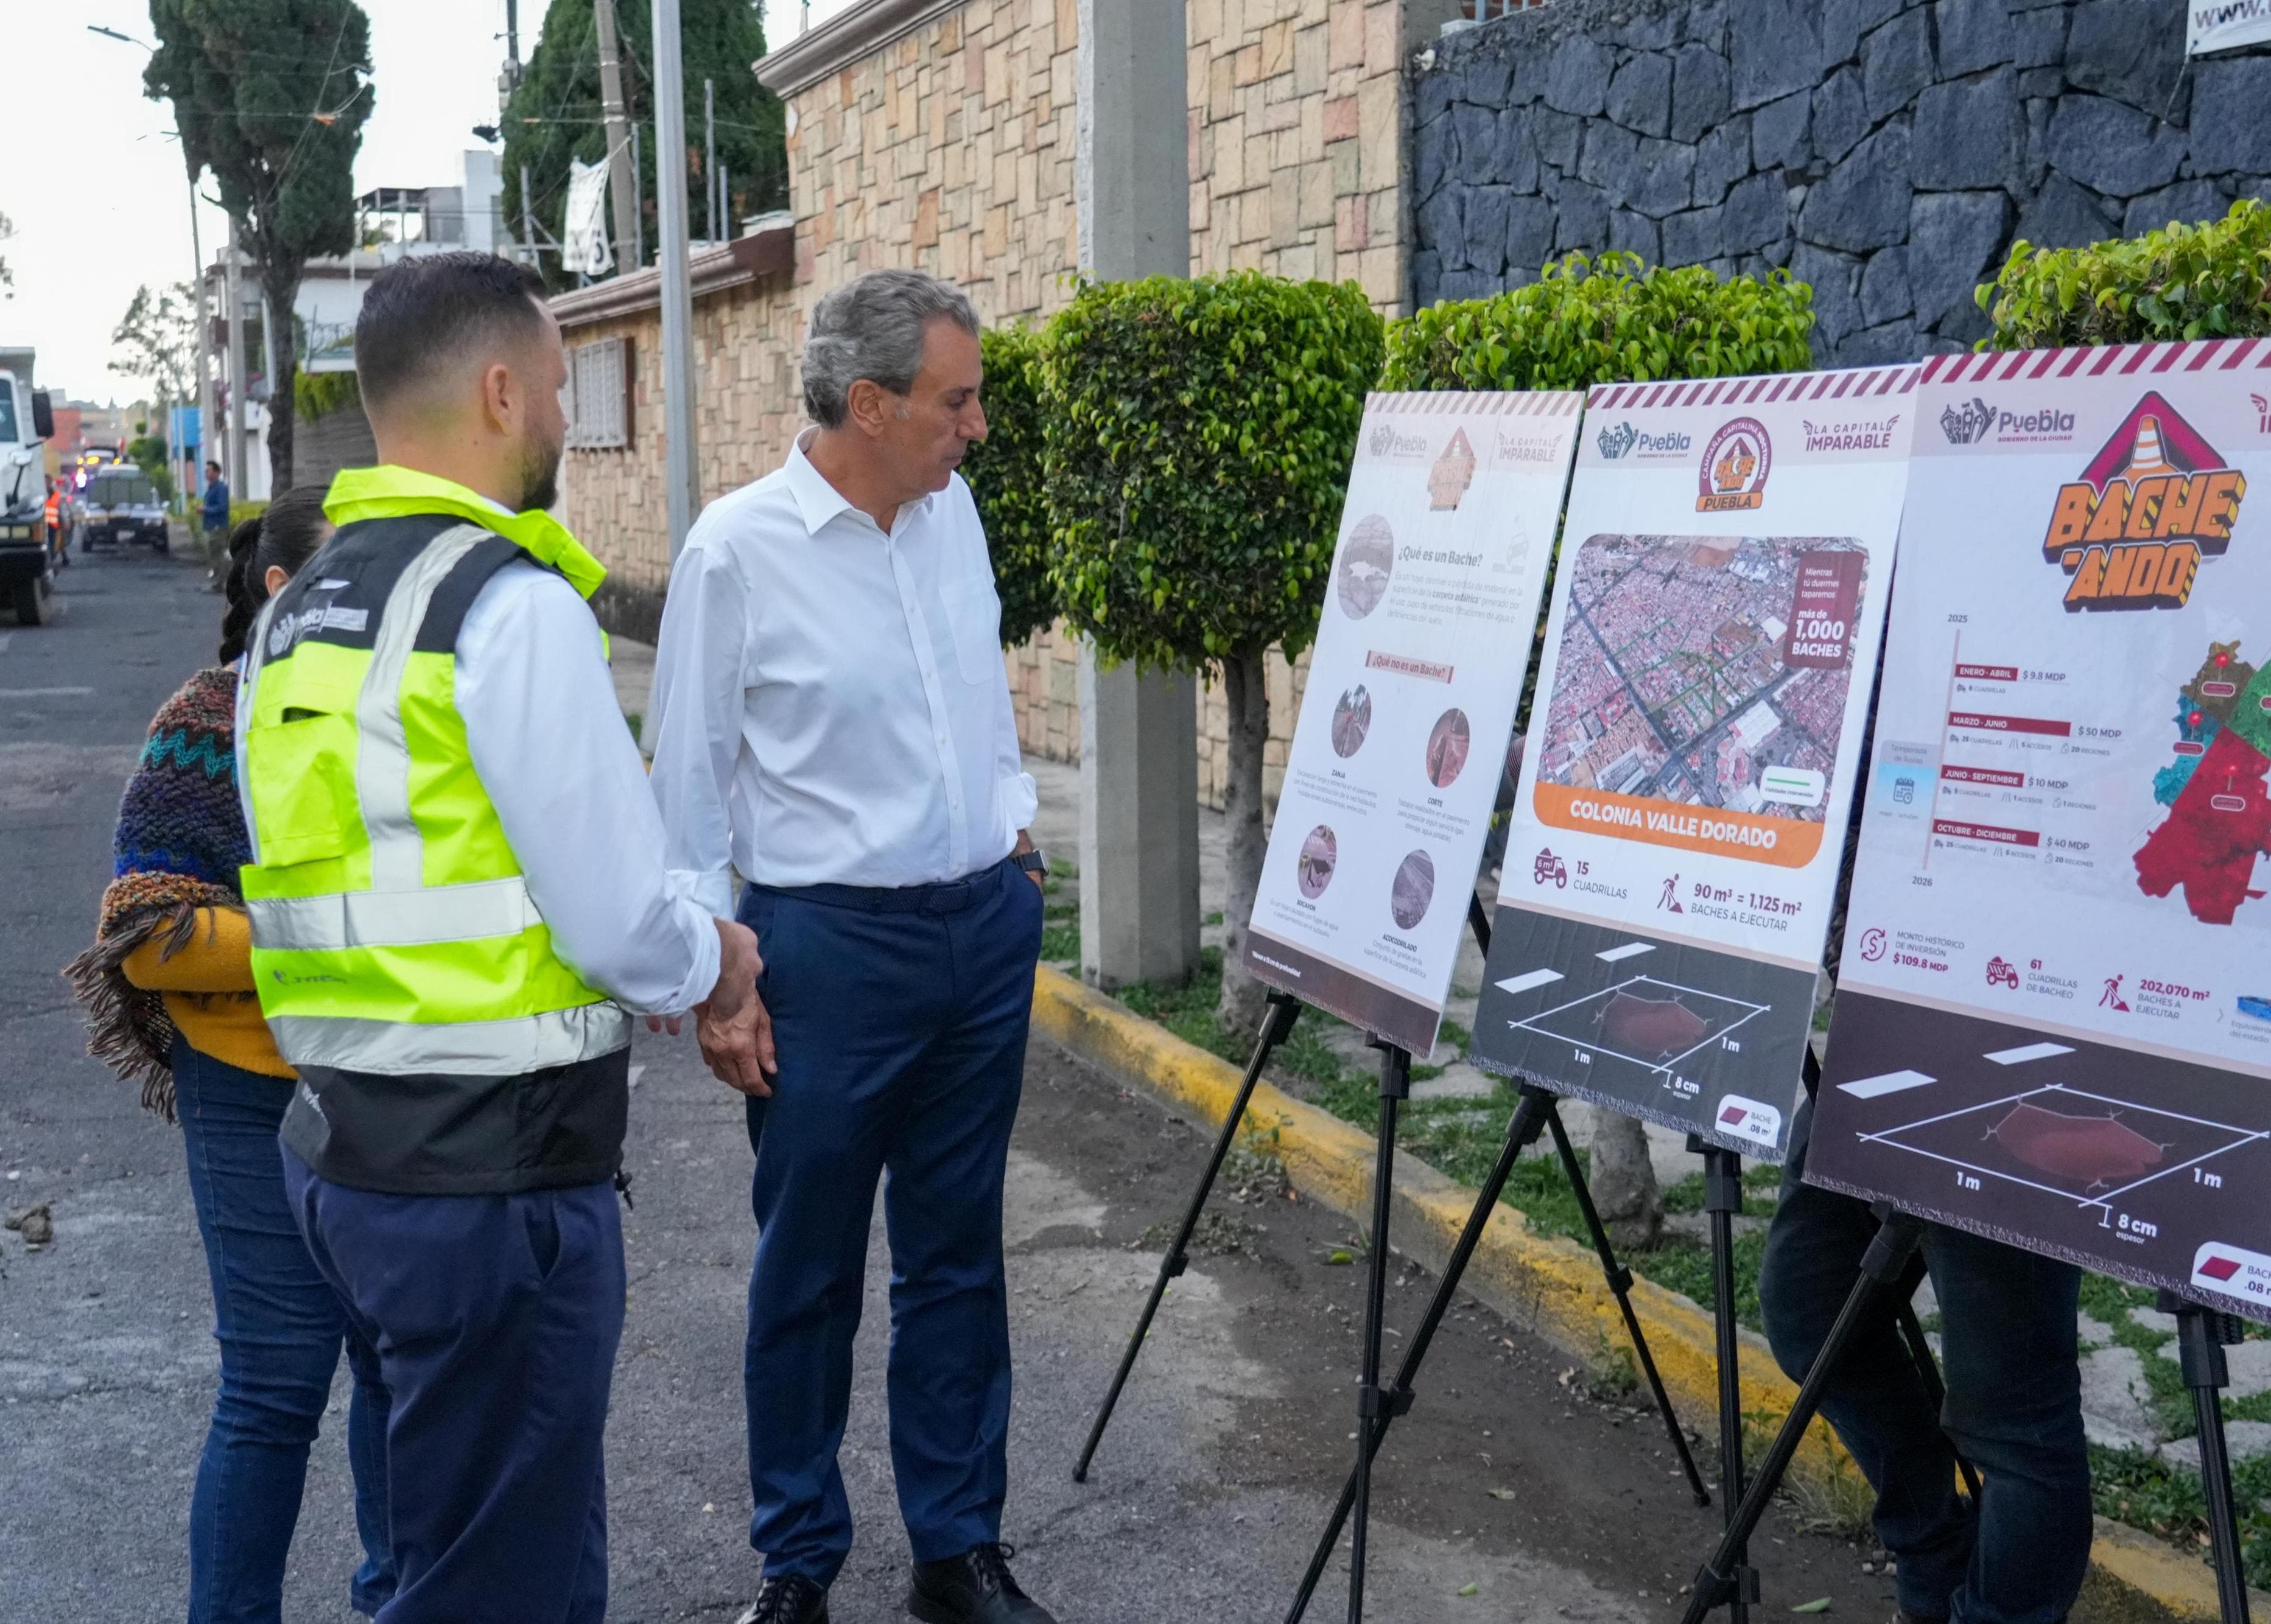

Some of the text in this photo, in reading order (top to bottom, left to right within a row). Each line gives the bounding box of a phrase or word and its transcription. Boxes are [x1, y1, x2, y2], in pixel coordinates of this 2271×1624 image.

[1814, 420, 1888, 433] LA CAPITAL
[1998, 408, 2075, 434] Puebla
[1638, 432, 1691, 452] Puebla
[1805, 433, 1891, 452] IMPARABLE
[1498, 447, 1556, 463] IMPARABLE
[1702, 422, 1768, 480] CAMPAÑA CAPITALINA NOCTURNA
[1704, 495, 1752, 510] PUEBLA
[2043, 470, 2246, 563] BACHE
[1398, 545, 1483, 567] ¿Qué es un Bache?
[1805, 567, 1833, 576] Mientras
[2062, 541, 2202, 612] ANDO
[1803, 579, 1839, 588] tú duermes
[1801, 590, 1836, 599] taparemos
[1798, 608, 1828, 619] más de
[1948, 614, 1968, 623] 2025
[1795, 618, 1845, 641] 1,000
[1792, 641, 1842, 658] BACHES
[1372, 655, 1445, 678] ¿Qué no es un Bache?
[1959, 667, 1985, 676] ENERO
[1990, 668, 2012, 678] ABRIL
[2023, 670, 2029, 681] $
[2030, 670, 2043, 681] 9.8
[2045, 672, 2066, 681] MDP
[1973, 685, 2006, 694] CUADRILLAS
[1953, 716, 1979, 726] MARZO
[1984, 719, 2008, 729] JUNIO
[2078, 726, 2085, 737] $
[2086, 727, 2098, 737] 50
[2100, 729, 2122, 738] MDP
[1970, 737, 2002, 746] CUADRILLAS
[1945, 769, 1967, 779] JUNIO
[1972, 772, 2019, 785] SEPTIEMBRE
[2028, 776, 2034, 787] $
[2035, 778, 2046, 787] 10
[2047, 780, 2069, 789] MDP
[1959, 788, 1992, 798] CUADRILLAS
[1427, 797, 1444, 808] CORTE
[1570, 799, 1778, 850] COLONIA VALLE DORADO
[1937, 824, 1972, 836] OCTUBRE
[1976, 828, 2018, 842] DICIEMBRE
[2046, 836, 2052, 847] $
[2054, 838, 2066, 848] 40
[2068, 840, 2090, 850] MDP
[1954, 842, 1987, 853] CUADRILLAS
[1537, 859, 1543, 867] 6
[1577, 860, 1590, 875] 15
[1912, 875, 1932, 887] 2026
[1573, 879, 1628, 900] CUADRILLAS
[1694, 883, 1712, 900] 90
[1713, 888, 1733, 903] m³
[1749, 892, 1781, 912] 1,125
[1781, 901, 1803, 916] m²
[1690, 902, 1789, 932] BACHES A EJECUTAR
[1897, 931, 1924, 942] MONTO
[1895, 941, 1947, 957] DE INVERSIÓN
[1893, 951, 1949, 973] $ 109.8 MDP
[2031, 959, 2042, 971] 61
[2027, 972, 2078, 989] CUADRILLAS
[2026, 984, 2074, 1000] DE BACHEO
[2139, 979, 2211, 1001] 202,070 m²
[2138, 993, 2181, 1009] BACHES A
[2135, 1004, 2180, 1020] EJECUTAR
[1722, 1036, 1740, 1053] 1 m
[1574, 1049, 1590, 1064] 1 m
[1674, 1076, 1700, 1094] 8 cm
[1750, 1111, 1772, 1125] BACHE
[1748, 1124, 1761, 1134] .08
[1957, 1171, 1981, 1191] 1 m
[2194, 1167, 2222, 1188] 1 m
[2118, 1213, 2158, 1237] 8 cm
[2116, 1231, 2145, 1245] espesor
[2244, 1280, 2264, 1294] .08
